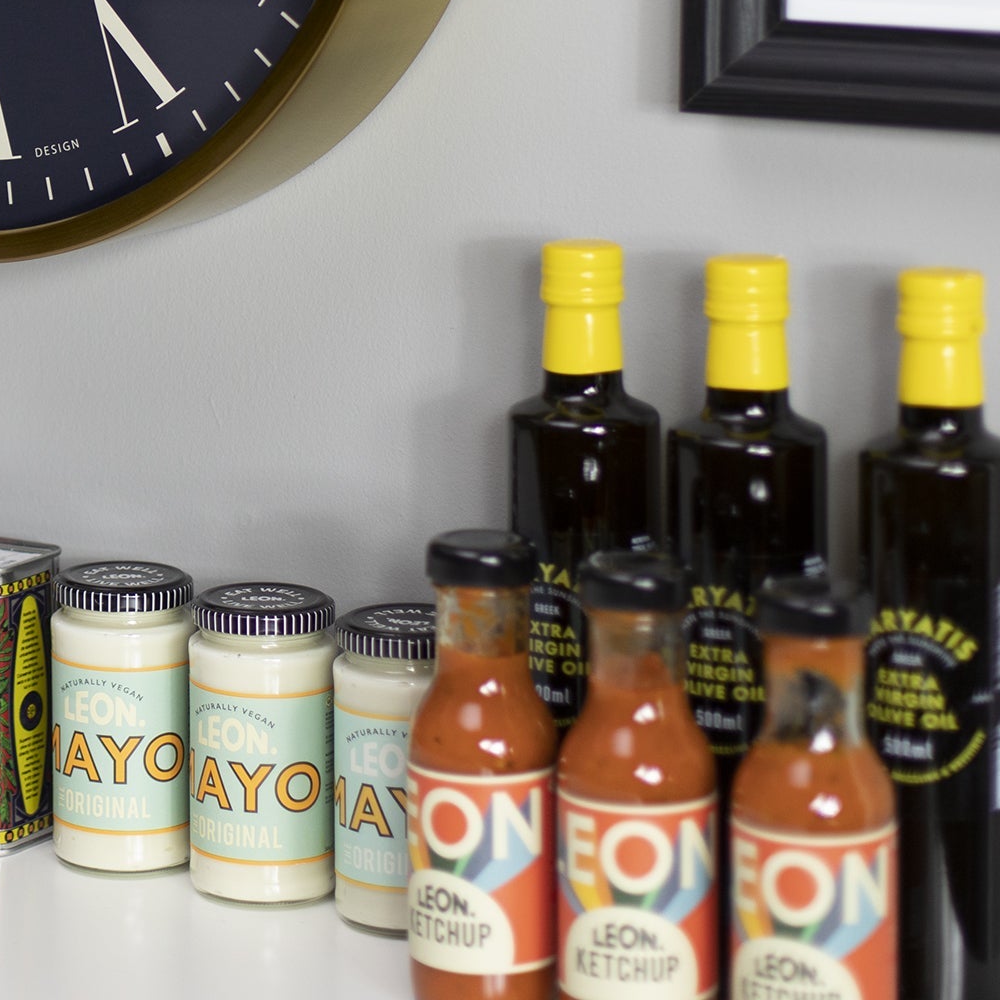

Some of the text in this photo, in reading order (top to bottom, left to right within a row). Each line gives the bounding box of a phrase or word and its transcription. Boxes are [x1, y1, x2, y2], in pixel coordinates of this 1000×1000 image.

[34, 138, 80, 158] DESIGN
[529, 620, 576, 639] XTRA
[529, 638, 581, 658] IRGIN
[689, 643, 748, 664] EXTRA
[686, 660, 754, 682] VIRGIN
[60, 678, 144, 702] NATURALLY VEGAN
[64, 690, 147, 728] LEON.
[242, 708, 276, 729] VEGAN
[197, 714, 279, 756] LEON.
[345, 728, 398, 743] NATURALLY
[65, 788, 152, 820] ORIGINAL
[199, 815, 283, 850] ORIGINAL
[417, 885, 476, 918] LEON.
[592, 923, 665, 951] LEON.
[576, 947, 680, 983] KETCHUP
[753, 953, 827, 988] LEON.
